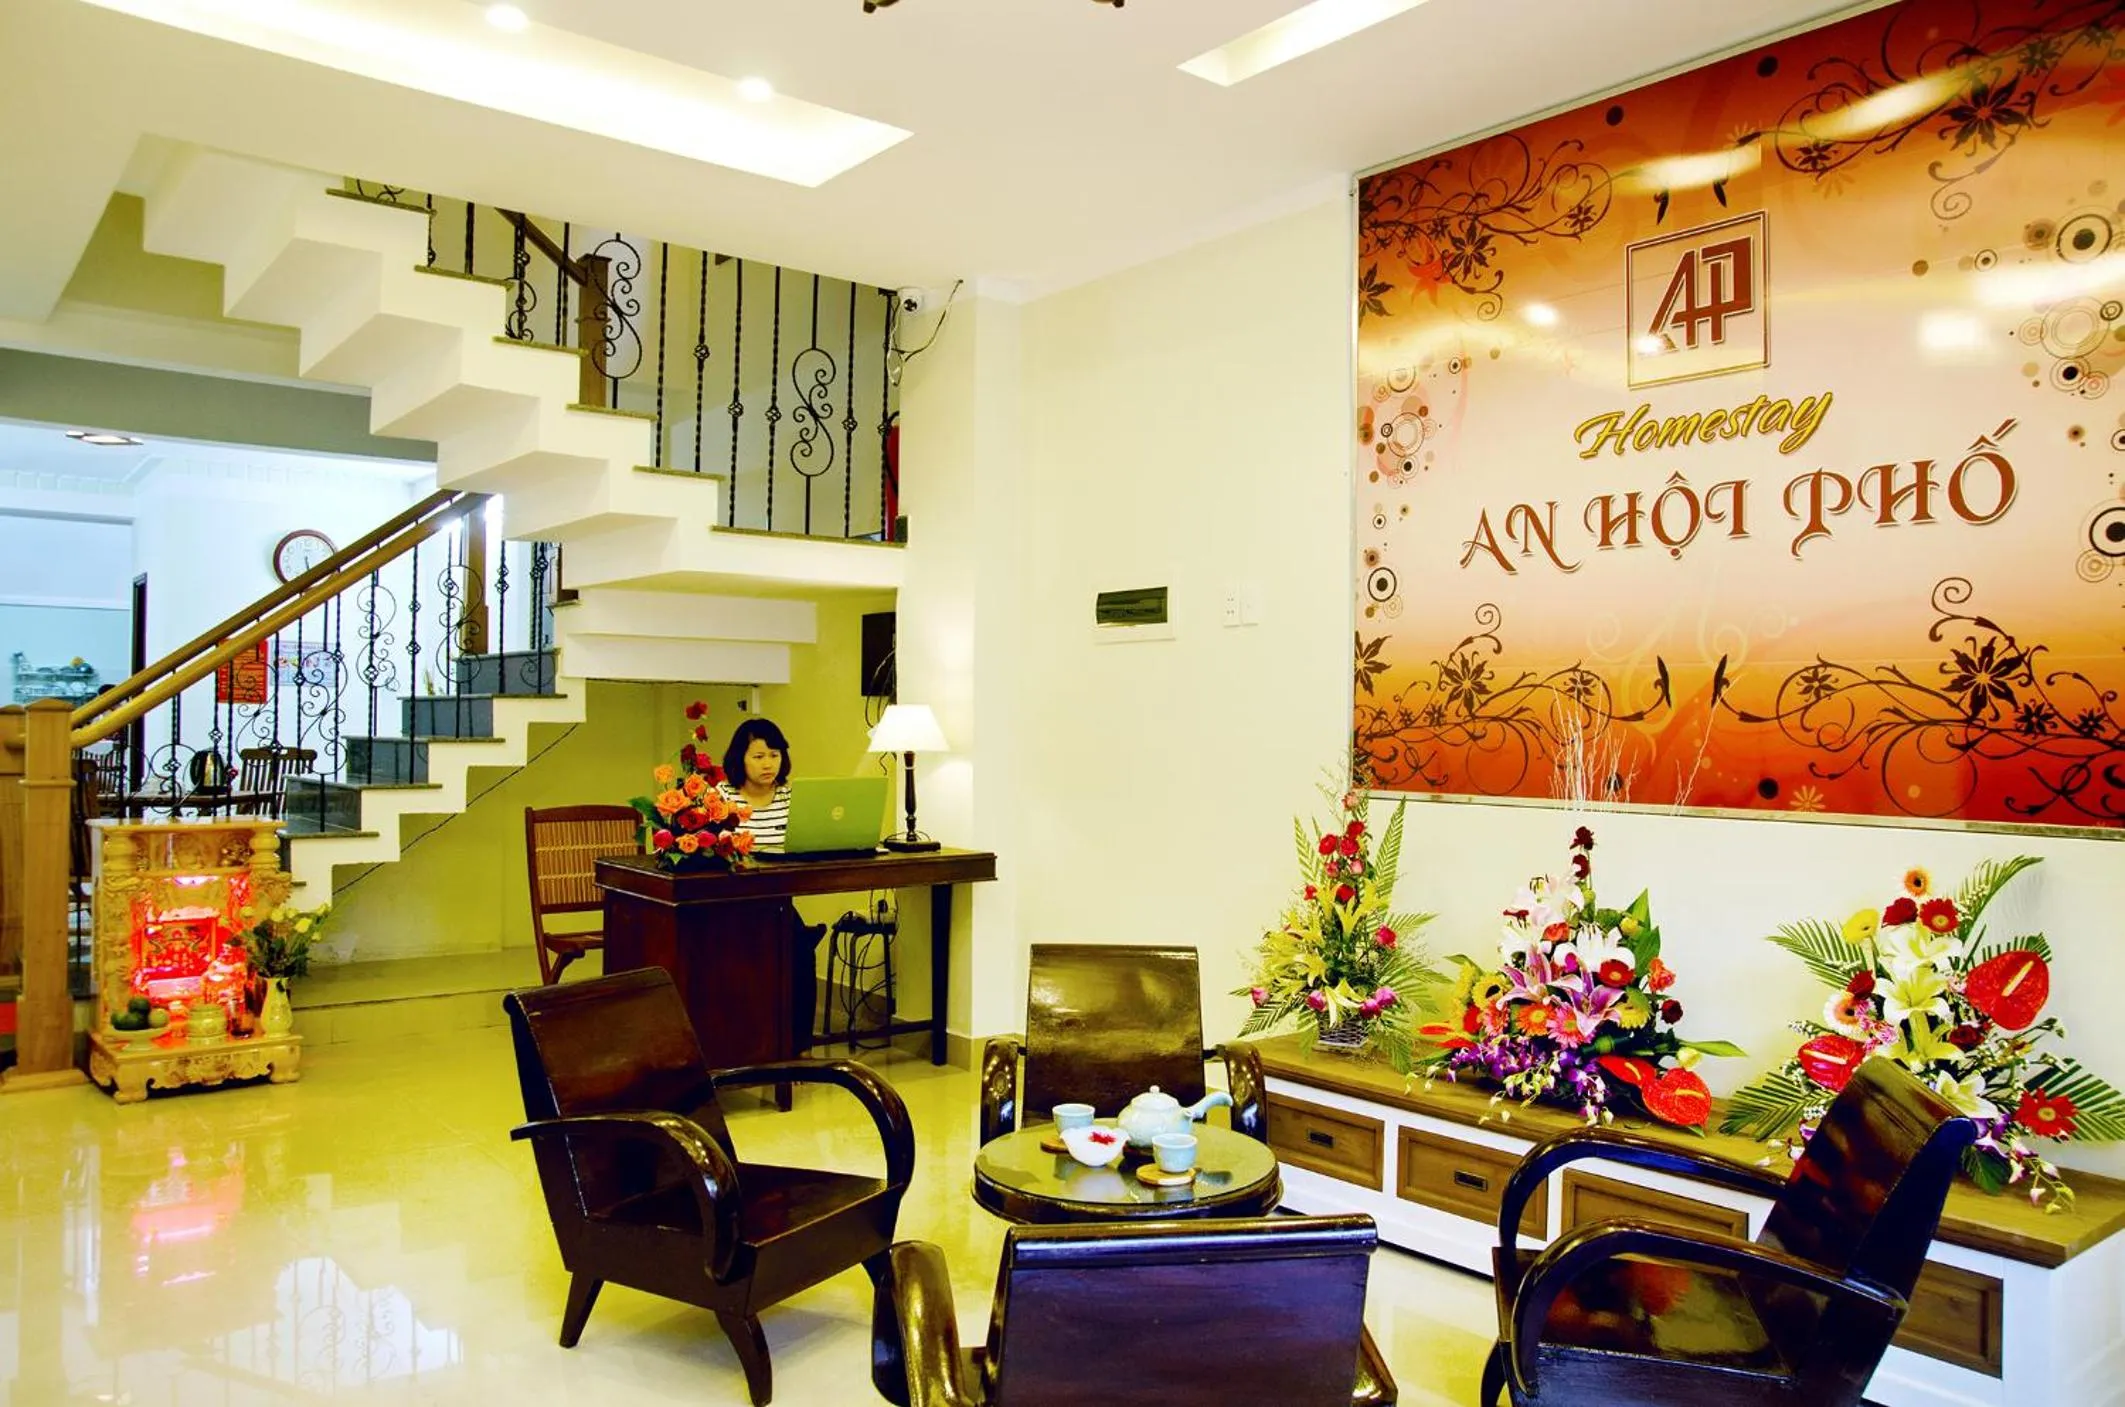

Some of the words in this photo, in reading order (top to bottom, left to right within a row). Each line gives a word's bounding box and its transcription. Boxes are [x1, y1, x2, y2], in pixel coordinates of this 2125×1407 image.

[1574, 390, 1833, 459] Homestay
[1459, 501, 1582, 574] AN
[1583, 470, 1751, 560] HỘI
[1782, 418, 2019, 560] PHỐ
